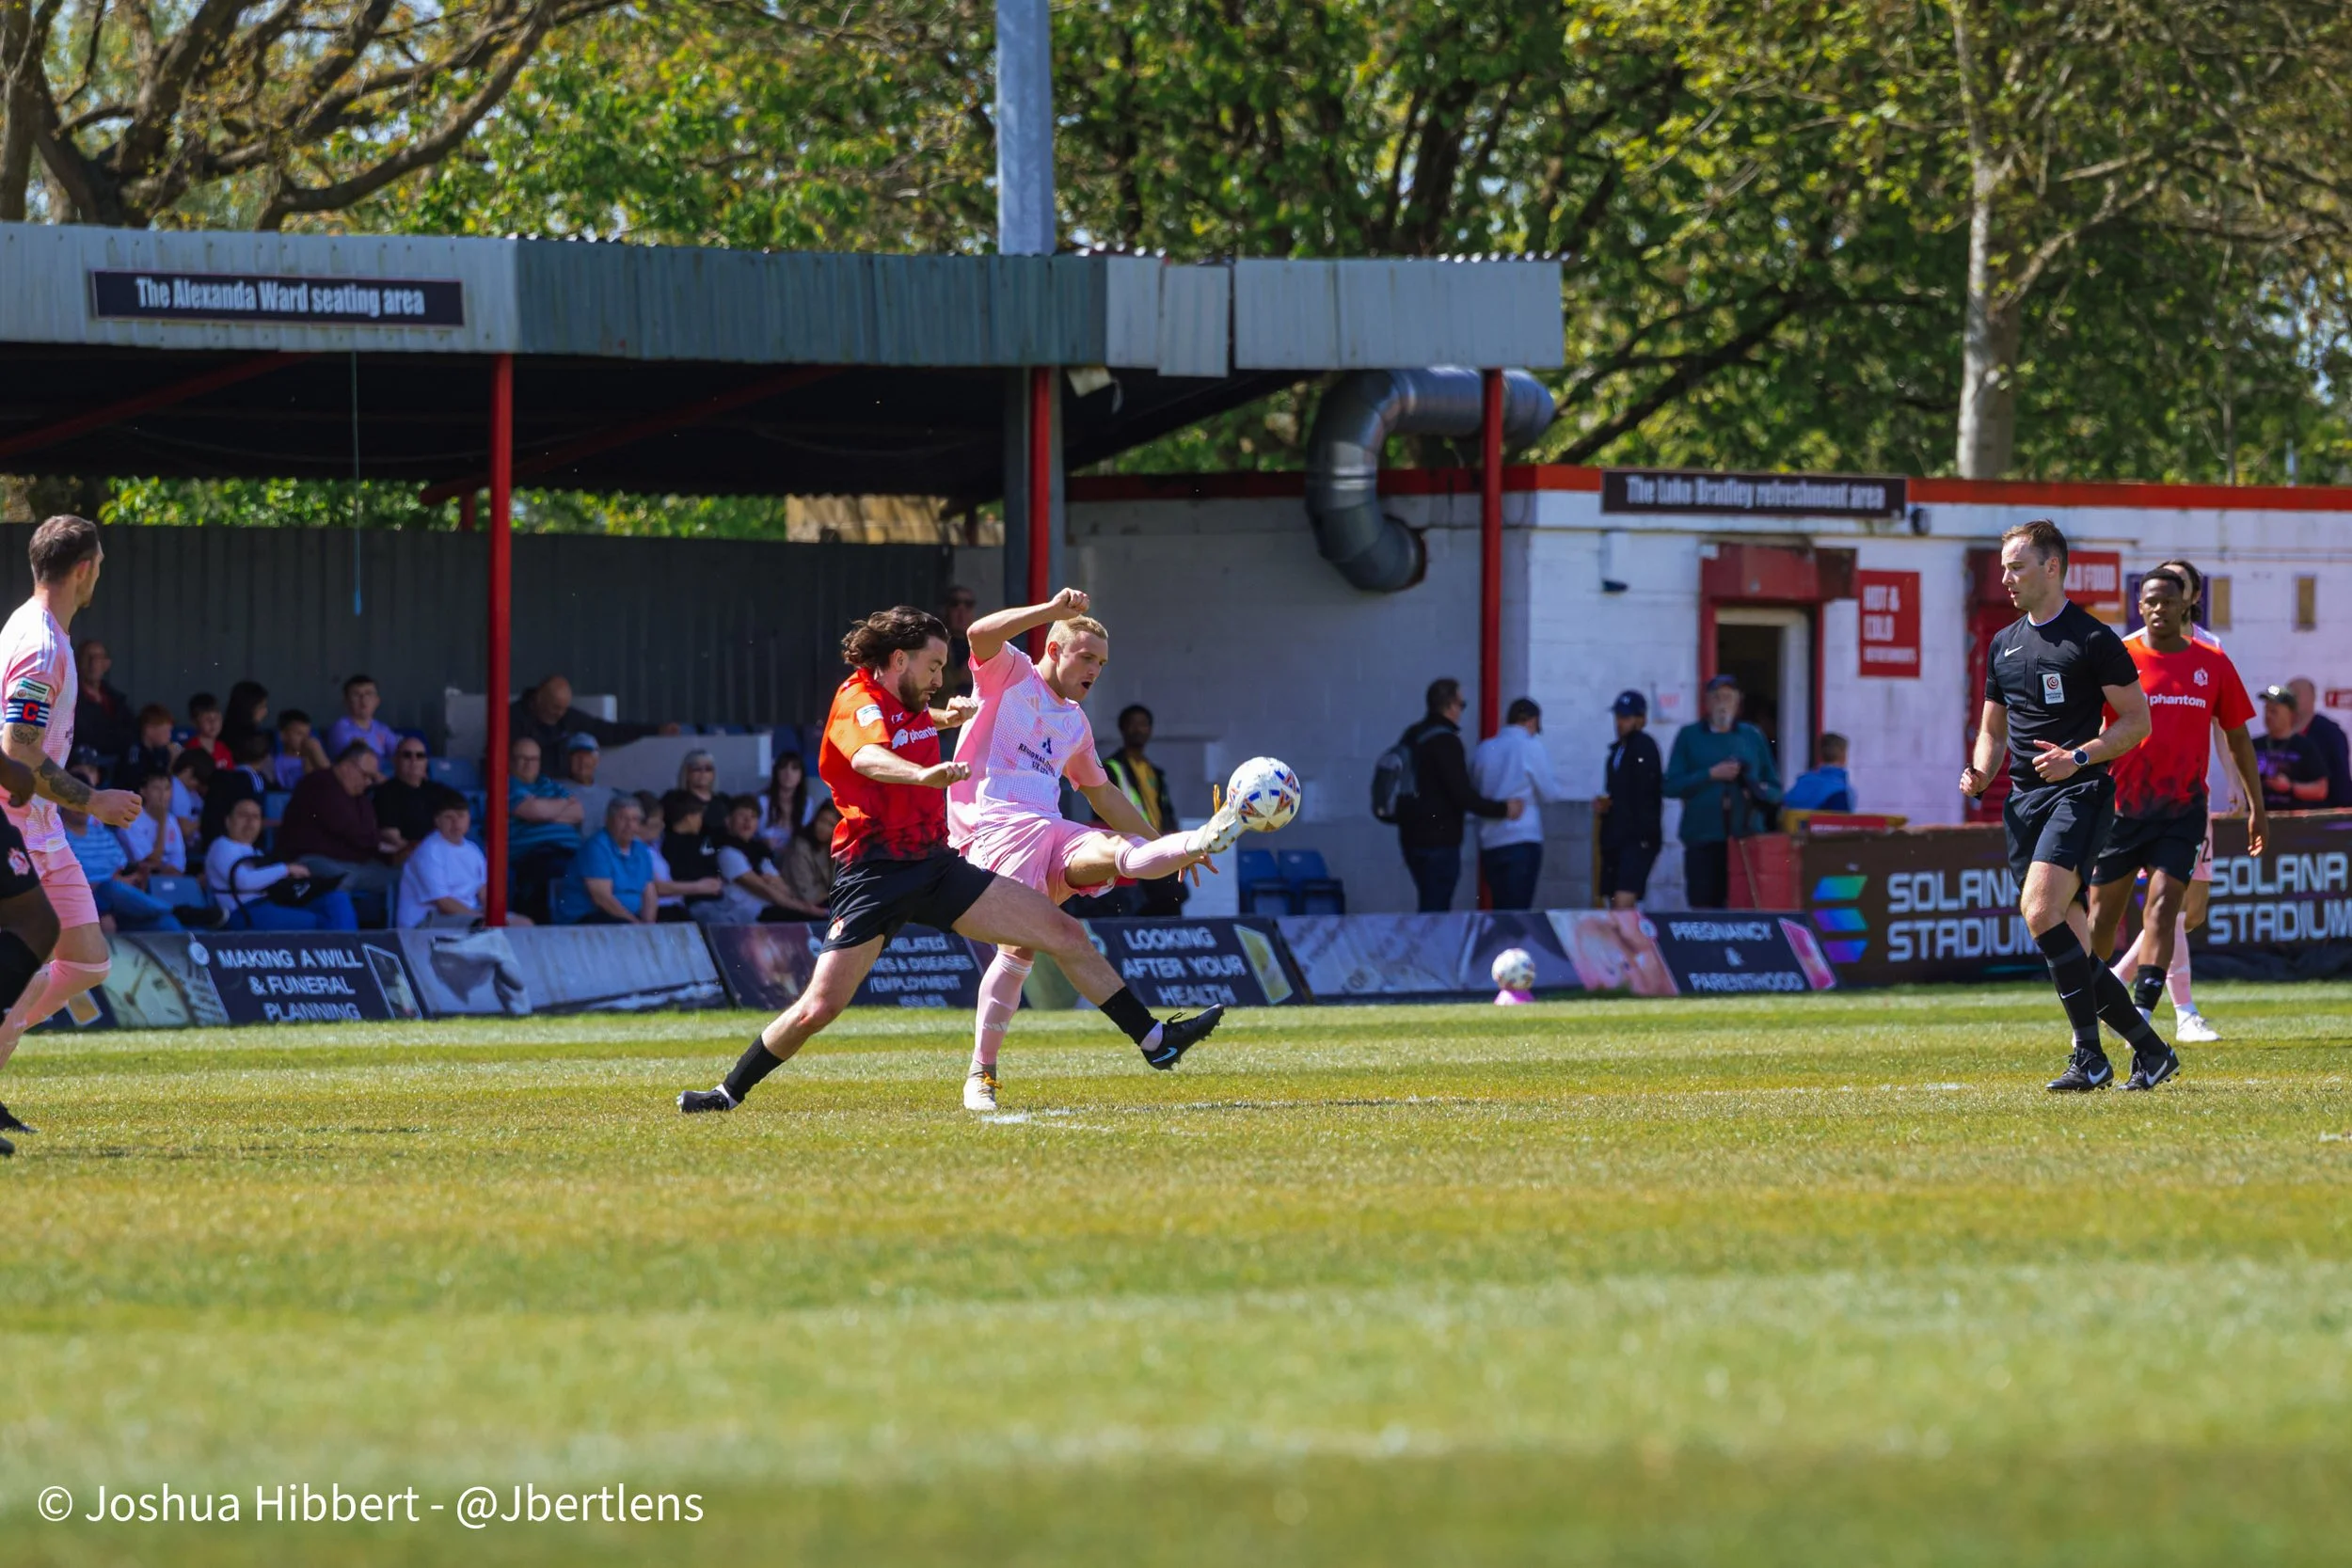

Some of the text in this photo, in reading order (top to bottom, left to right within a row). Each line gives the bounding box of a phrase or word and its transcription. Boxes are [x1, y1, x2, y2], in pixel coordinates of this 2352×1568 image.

[135, 277, 425, 317] The Alexanda Ward seating area
[1626, 474, 1655, 504] The
[1756, 478, 1848, 509] refreshment
[1850, 483, 1885, 510] area
[2063, 563, 2117, 593] LD FOOD
[1864, 585, 1887, 611] HOT
[22, 702, 40, 721] C
[2150, 693, 2207, 709] phantom
[910, 726, 938, 743] phanto
[2209, 853, 2348, 896] SOLANA
[1669, 921, 1773, 942] PREGNANCY
[2208, 899, 2352, 944] STADIUM
[1123, 926, 1217, 951] LOOKING
[215, 948, 364, 968] MAKING A WILL
[907, 954, 975, 972] DISEASES
[1121, 954, 1248, 979] AFTER YOUR
[247, 975, 357, 996] & FUNERAL
[1688, 973, 1805, 991] PARENTHOOD
[1155, 983, 1237, 1006] HEALTH
[262, 1002, 362, 1022] PLANNING
